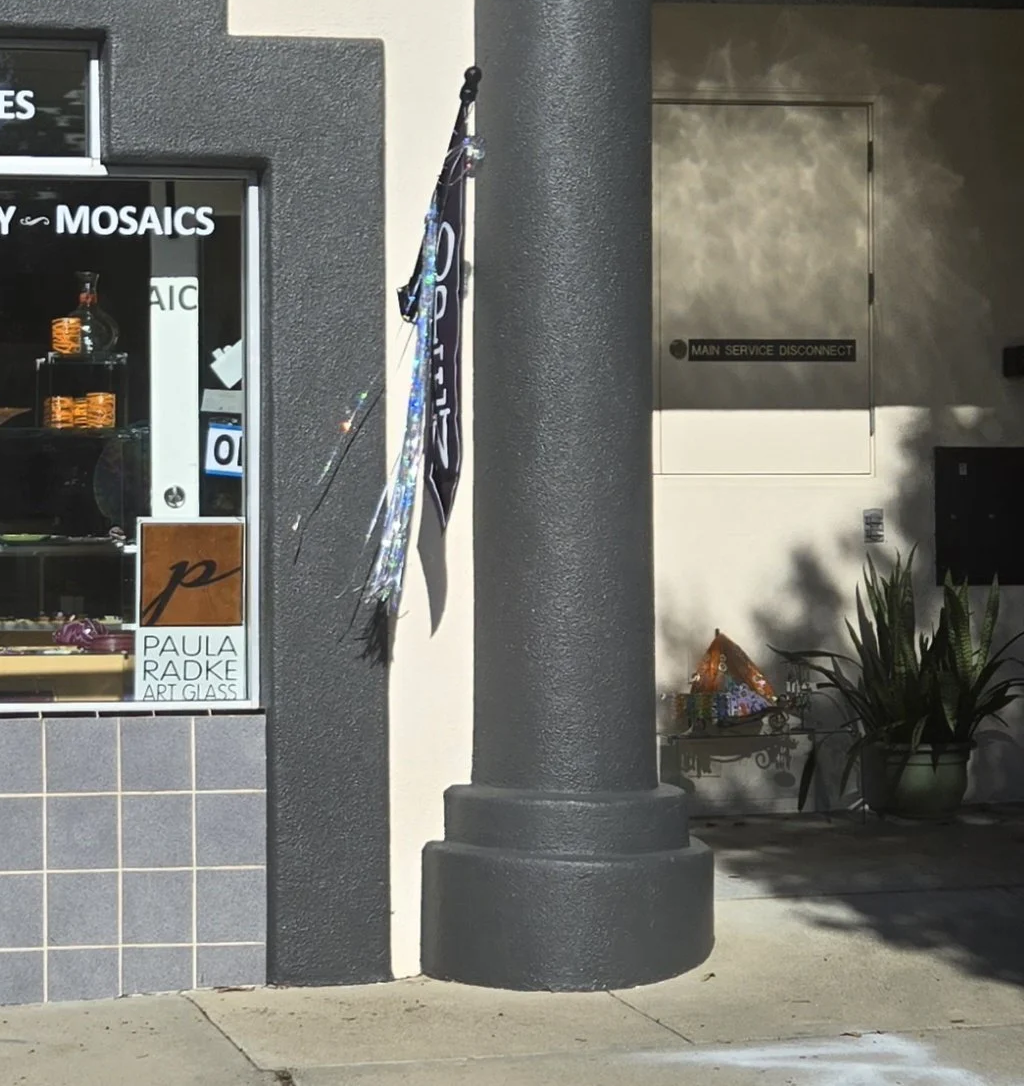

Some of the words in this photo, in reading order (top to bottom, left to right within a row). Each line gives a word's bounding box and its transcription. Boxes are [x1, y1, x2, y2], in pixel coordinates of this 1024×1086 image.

[56, 204, 216, 236] MOSAICS
[691, 345, 720, 356] MAIN
[725, 345, 774, 356] SERVICE
[779, 345, 853, 356] DISCONNECT
[143, 635, 238, 657] PAULA
[143, 659, 238, 681] RADKE
[143, 683, 176, 701] ART
[182, 683, 237, 701] GLASS
